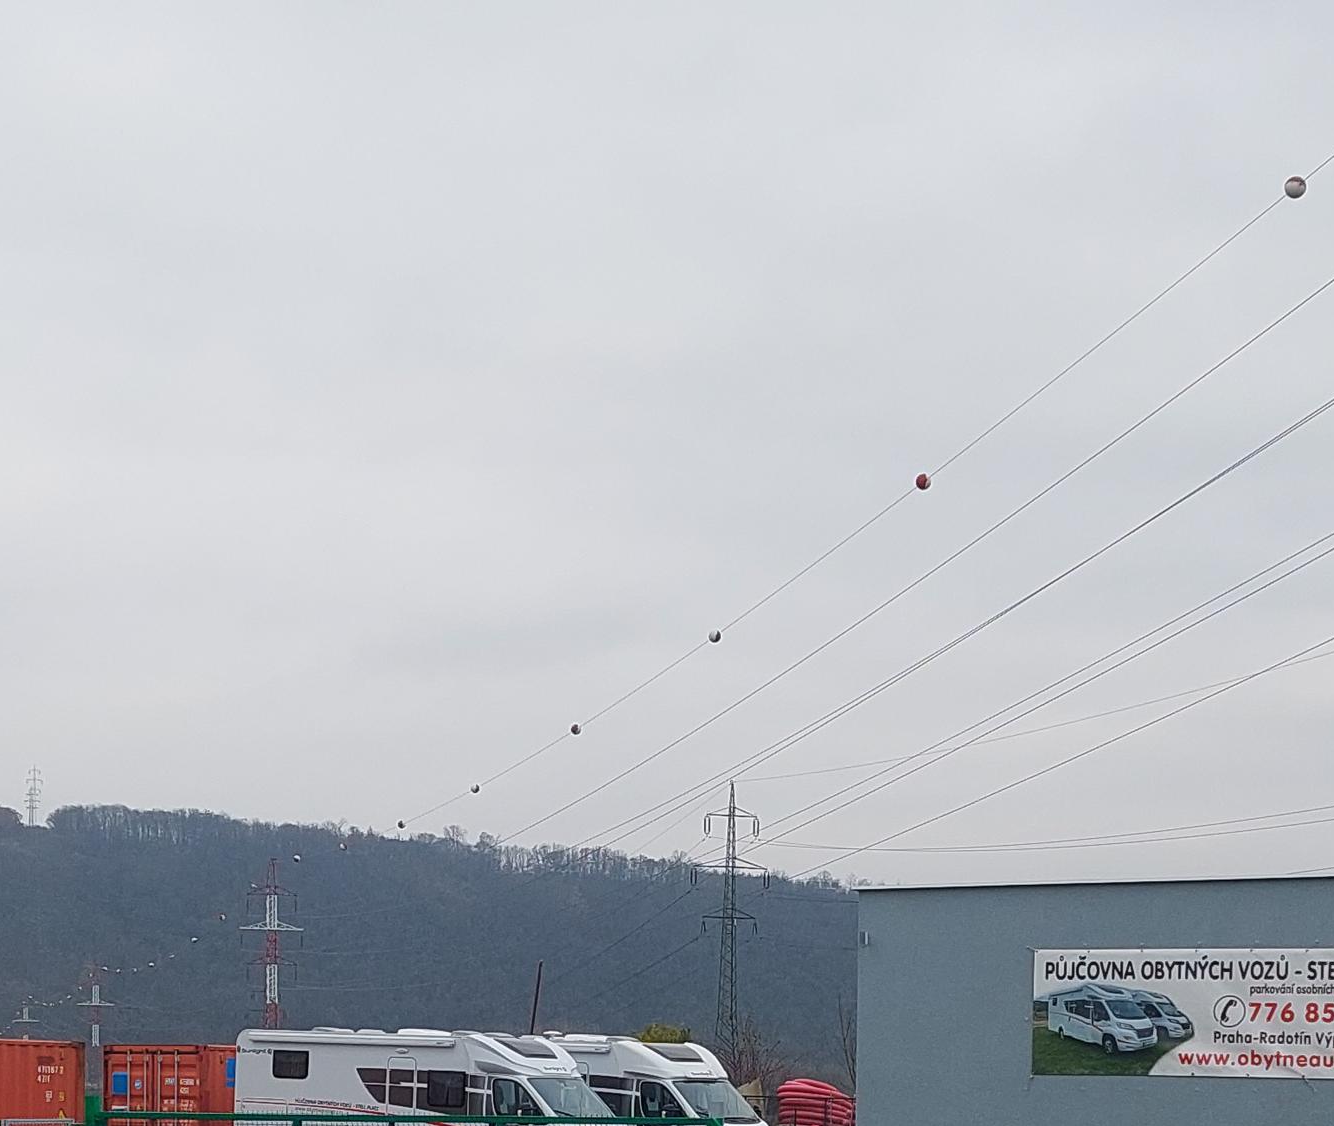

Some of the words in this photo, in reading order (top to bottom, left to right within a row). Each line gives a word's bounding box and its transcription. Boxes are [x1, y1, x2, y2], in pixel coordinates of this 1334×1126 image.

[1045, 955, 1136, 980] PŮJČOVNA
[1141, 955, 1233, 980] OBYTNÝCH
[1238, 954, 1289, 980] VOZŮ
[1249, 983, 1295, 997] parkování
[1248, 1002, 1295, 1023] 776
[1213, 1031, 1312, 1045] Praha-Radotín
